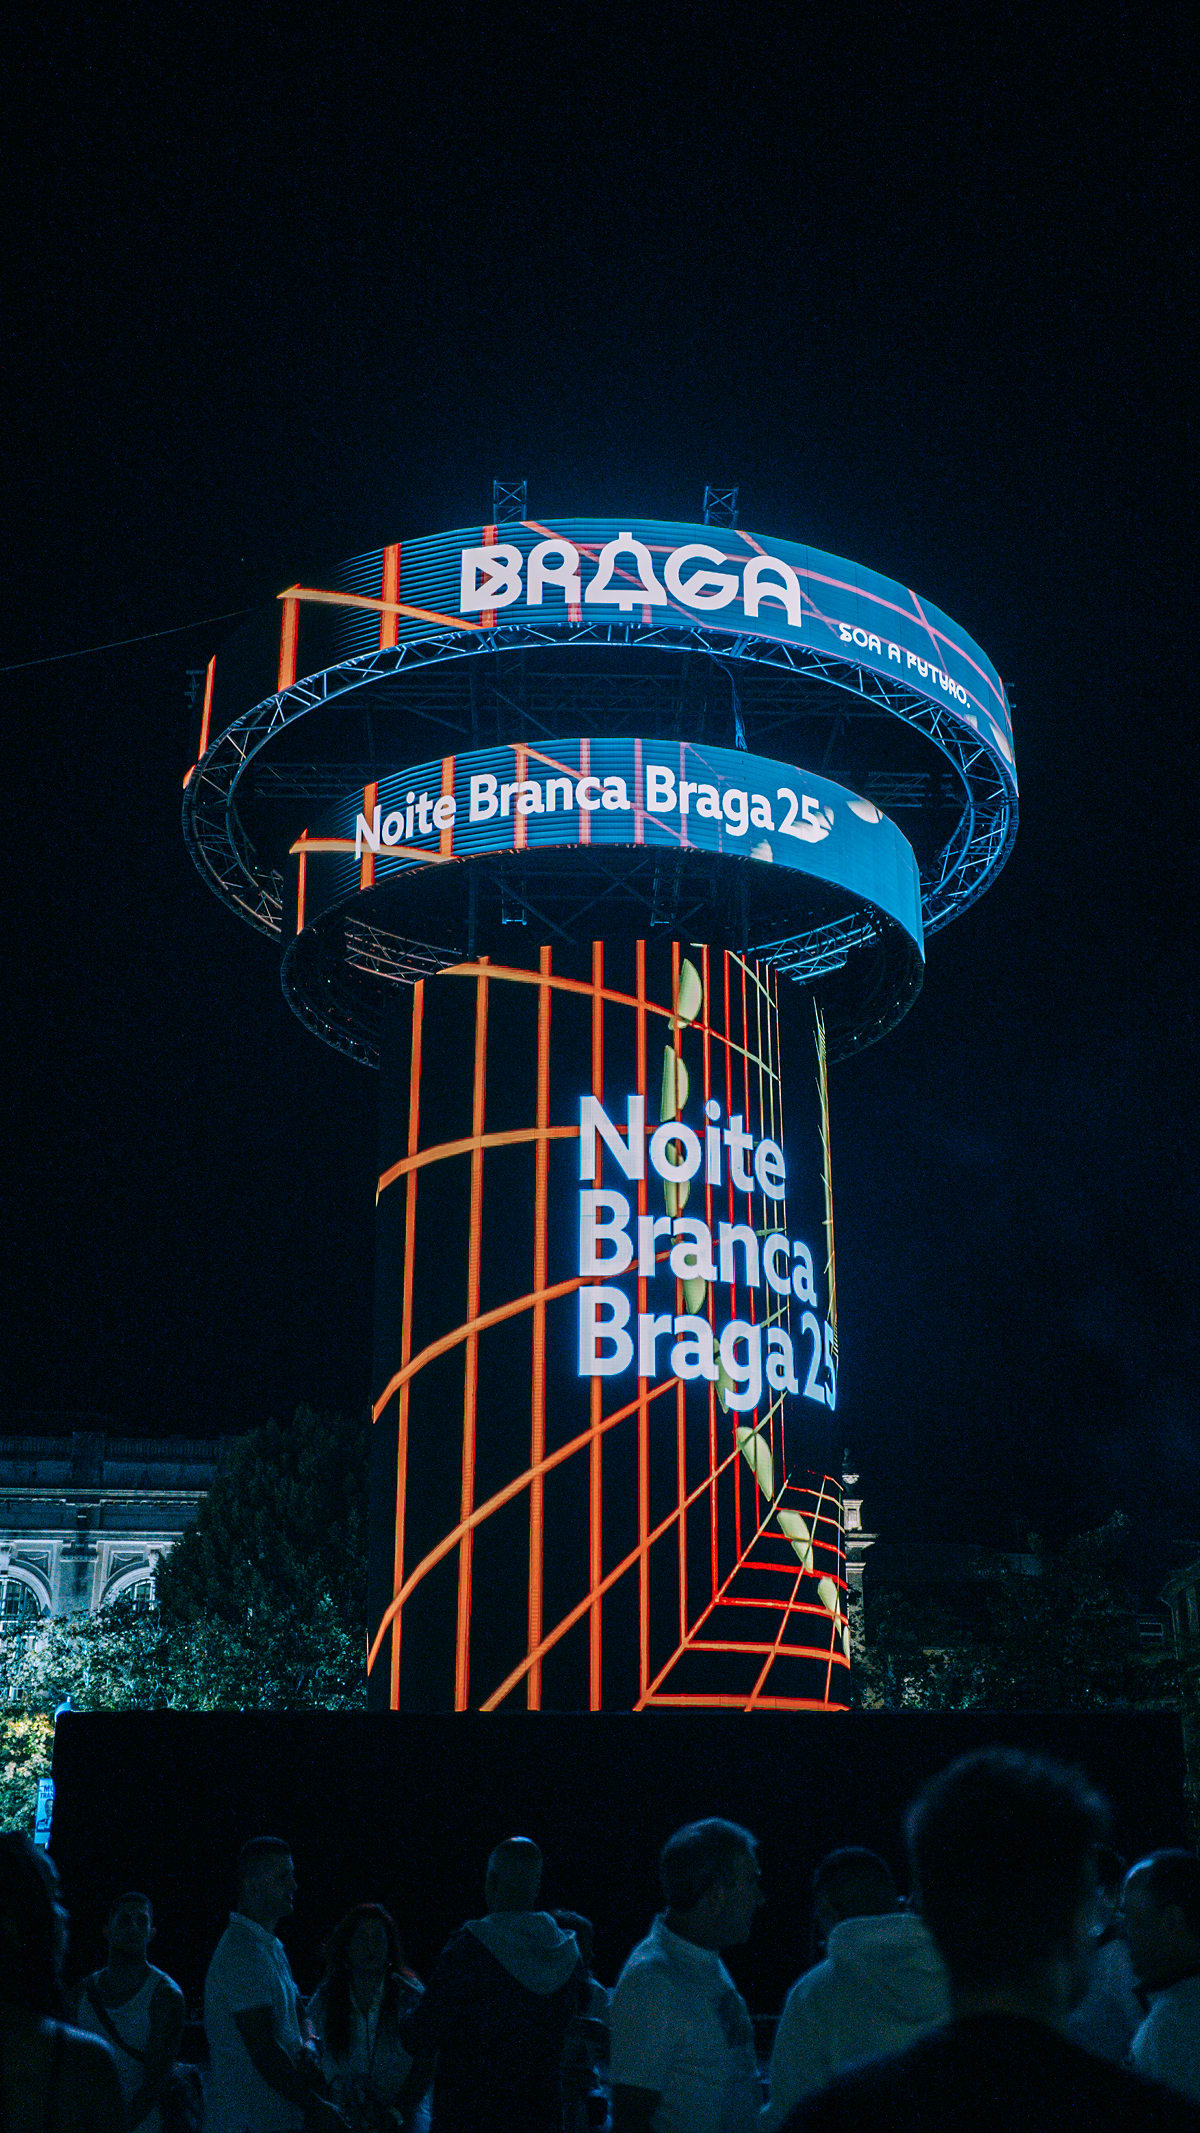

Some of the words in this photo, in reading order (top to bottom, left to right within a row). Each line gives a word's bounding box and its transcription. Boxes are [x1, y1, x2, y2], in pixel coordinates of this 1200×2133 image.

[460, 532, 802, 627] BRAGA
[838, 622, 882, 655] SOA
[887, 643, 901, 664] A
[355, 791, 457, 860] Noite
[468, 773, 630, 823] Branca
[579, 1095, 786, 1200] Noite
[579, 1189, 817, 1307] Branca
